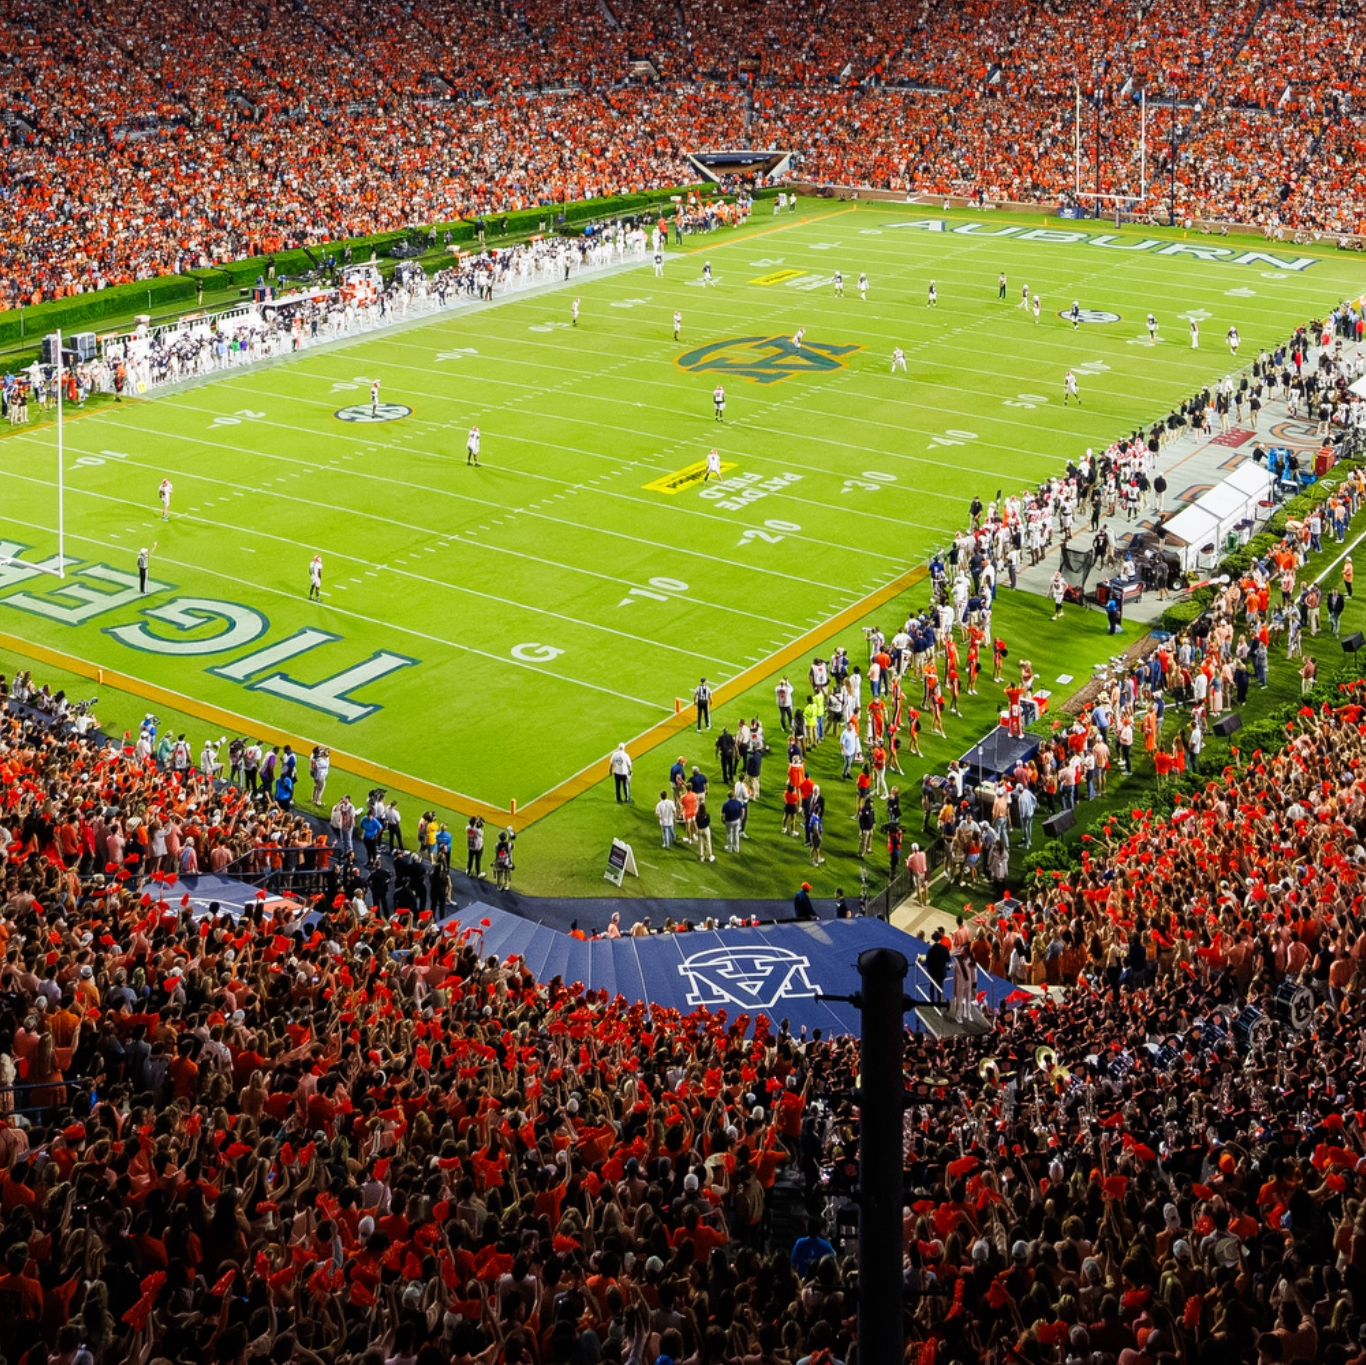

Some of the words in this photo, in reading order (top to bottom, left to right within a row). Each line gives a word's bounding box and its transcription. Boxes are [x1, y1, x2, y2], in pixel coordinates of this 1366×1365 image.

[879, 219, 1322, 271] AUBURN
[1003, 393, 1048, 410] 50
[932, 429, 978, 446] 40
[699, 472, 764, 499] FIELD
[758, 471, 804, 492] PAT
[844, 470, 897, 491] 30
[714, 489, 768, 511] DYE
[742, 519, 802, 544] 20
[628, 576, 689, 602] 10
[510, 642, 565, 662] G
